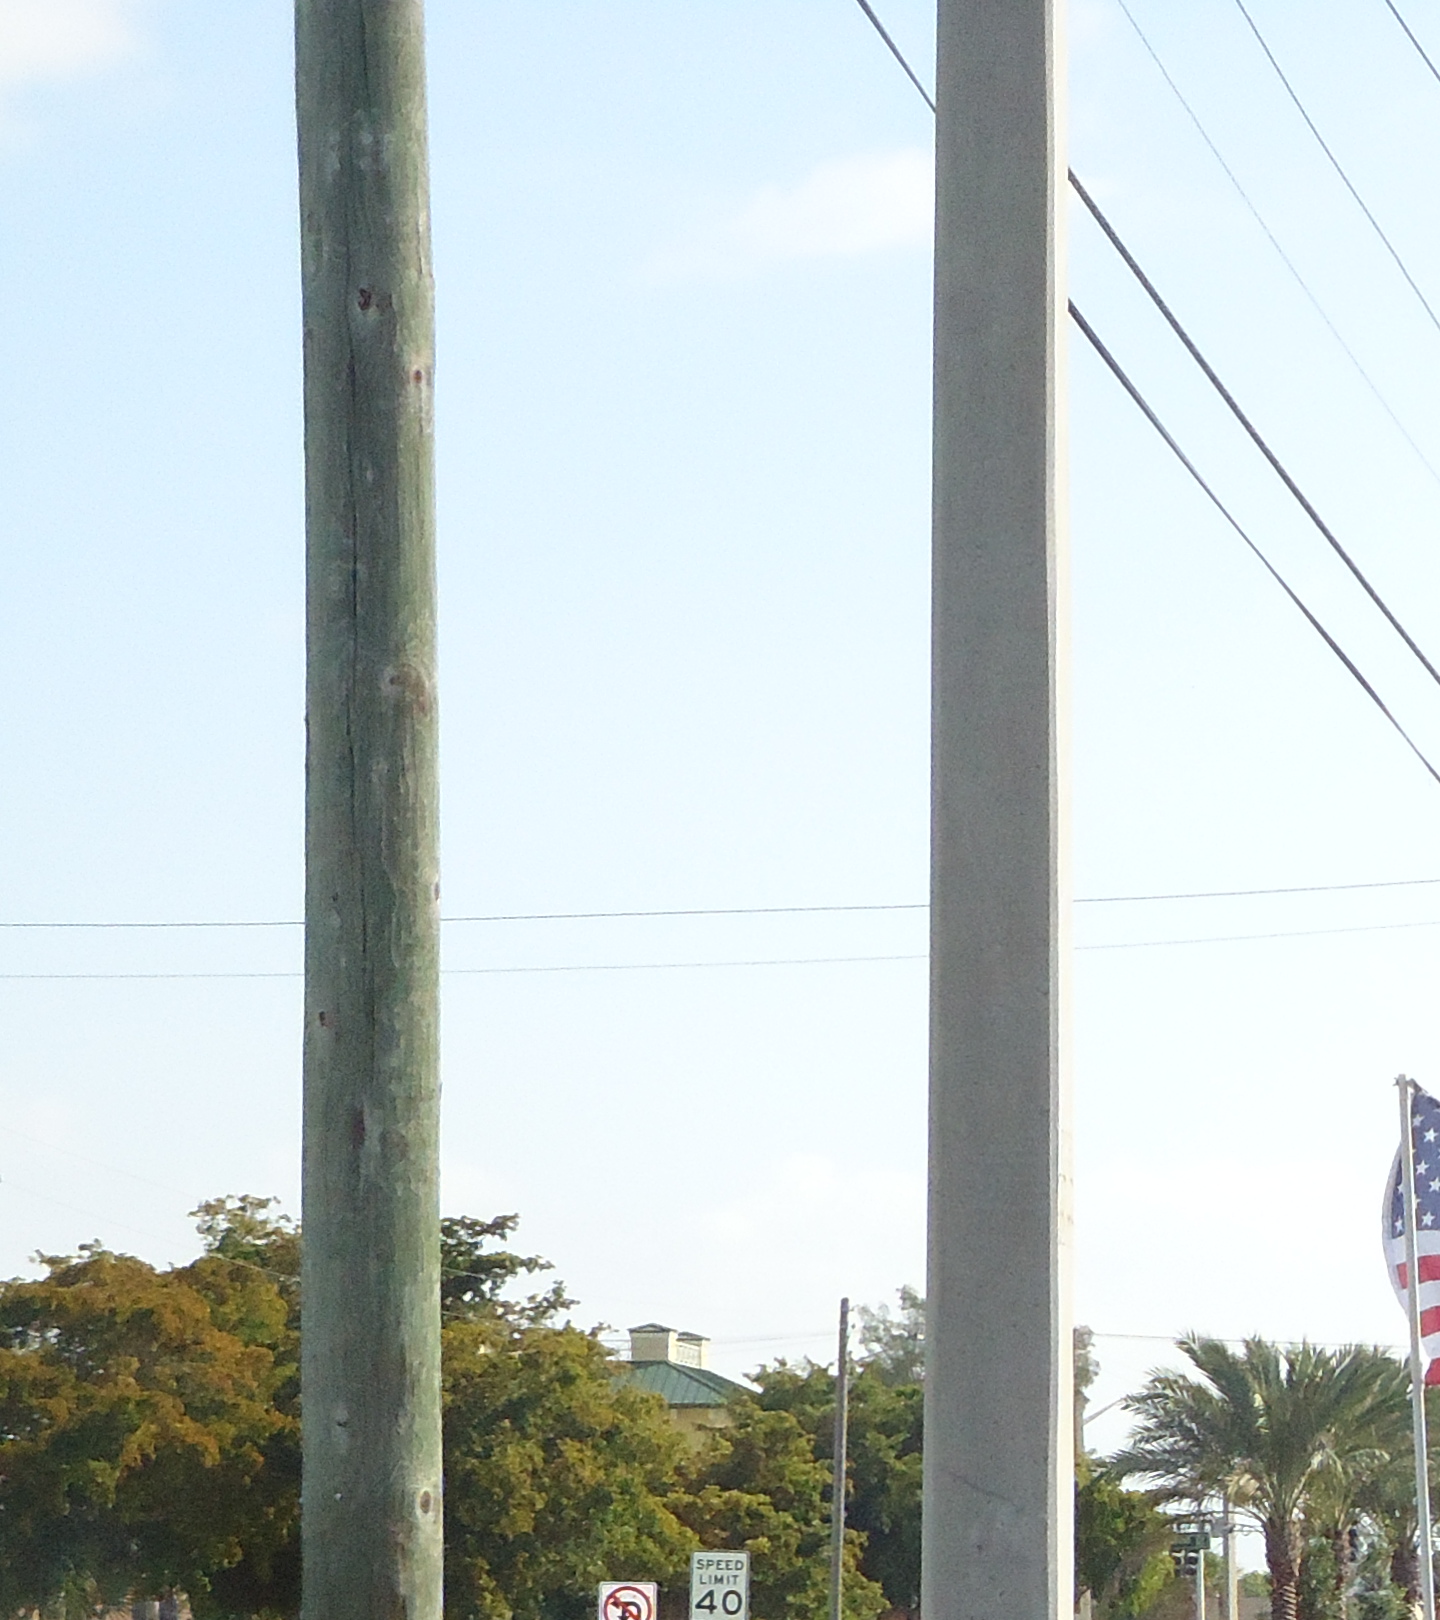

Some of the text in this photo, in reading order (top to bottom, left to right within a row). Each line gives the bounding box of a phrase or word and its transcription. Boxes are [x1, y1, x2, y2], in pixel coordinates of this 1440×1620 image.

[695, 1558, 745, 1572] SPEED
[699, 1574, 739, 1586] LIMIT
[694, 1588, 743, 1616] 40
